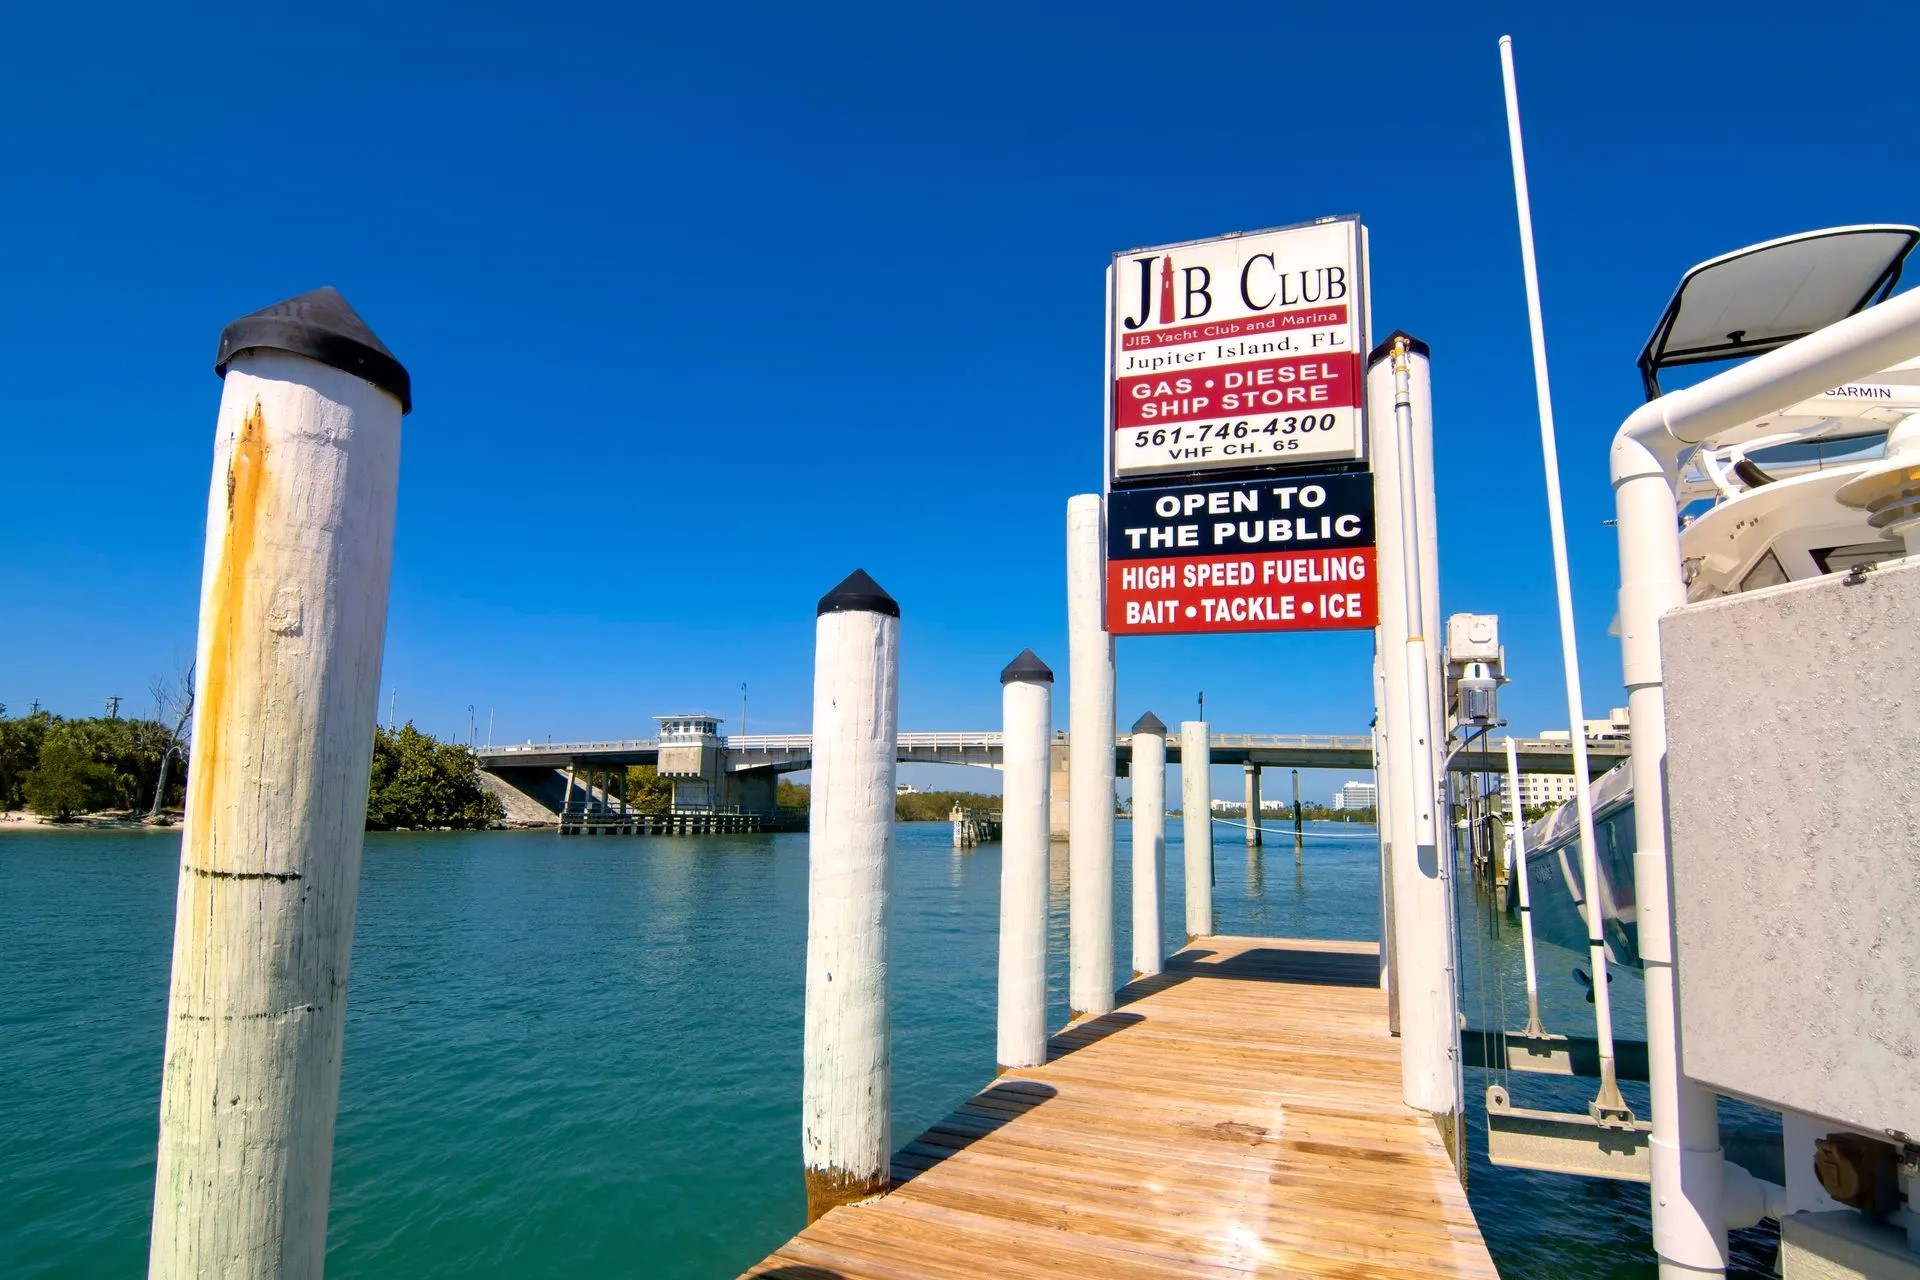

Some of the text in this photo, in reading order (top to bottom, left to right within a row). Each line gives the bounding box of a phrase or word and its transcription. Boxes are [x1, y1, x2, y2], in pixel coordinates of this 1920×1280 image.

[1240, 252, 1347, 310] CLUB
[1126, 311, 1338, 347] JIB Yacht Club and Marina
[1126, 332, 1345, 370] Jupiter Island, FL
[1132, 363, 1339, 399] GAS DIESEL
[1141, 384, 1329, 418] SHIP STORE
[1135, 413, 1336, 448] 561-746-4300
[1168, 439, 1299, 460] VHF CH. 65
[1155, 485, 1327, 518] OPEN TO
[1124, 514, 1361, 549] THE PUBLIC
[1122, 555, 1366, 590] HIGH SPEED FUELING
[1126, 593, 1362, 624] BAIT TACKLE ICE
